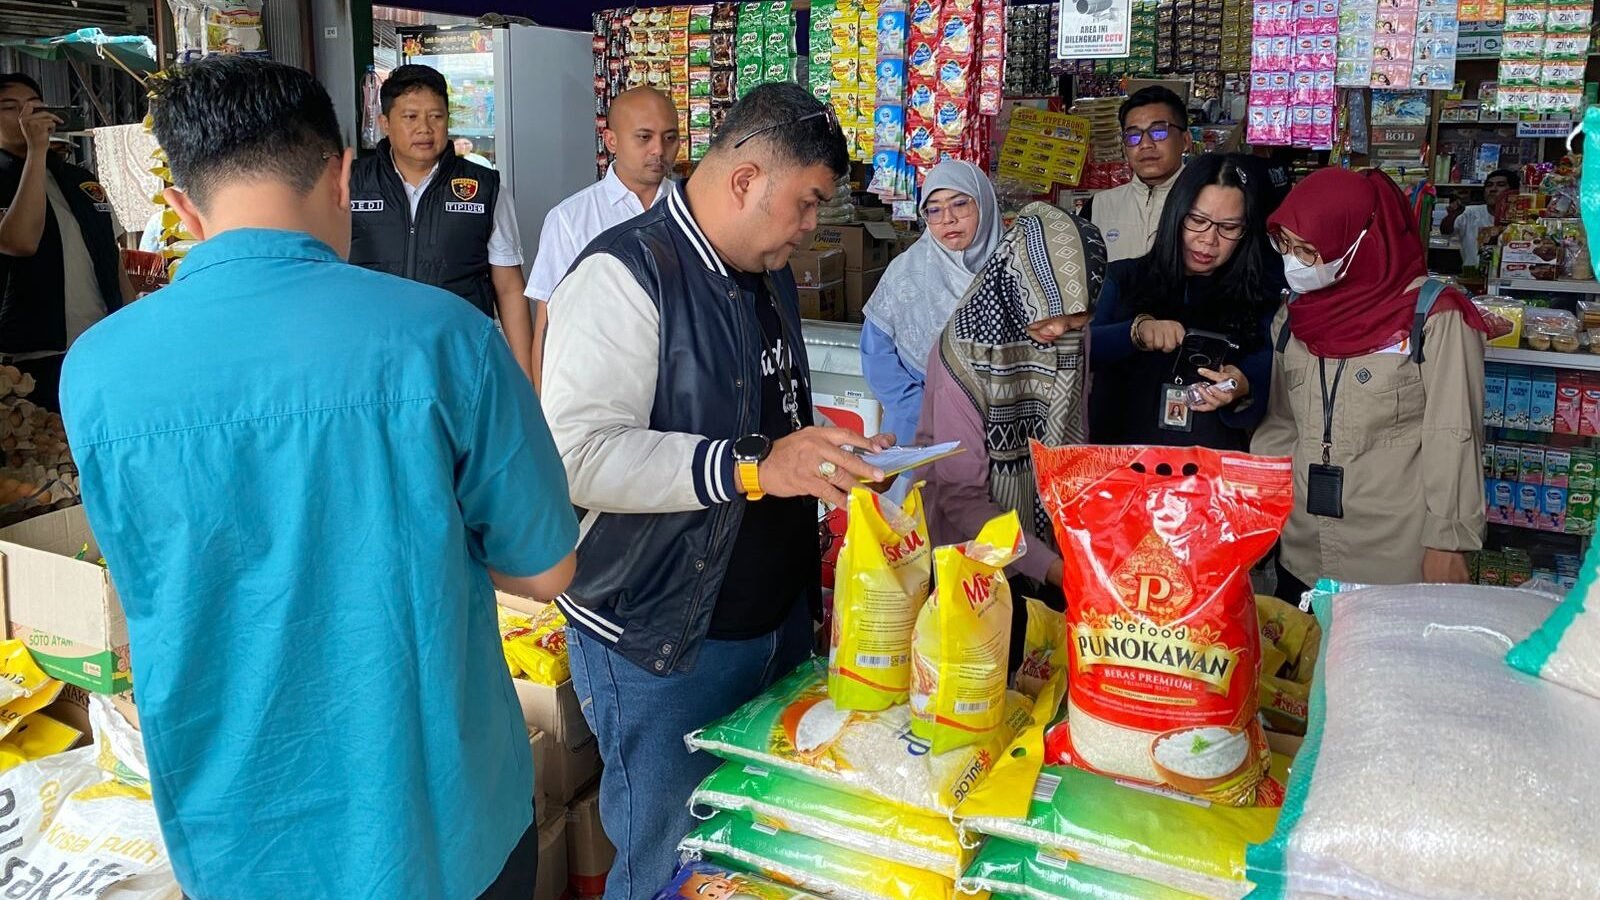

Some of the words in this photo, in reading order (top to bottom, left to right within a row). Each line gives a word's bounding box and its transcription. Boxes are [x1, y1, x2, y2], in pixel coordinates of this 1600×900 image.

[1559, 13, 1580, 21] ZINC
[1080, 25, 1097, 33] AREA
[1098, 25, 1108, 33] INI
[1065, 34, 1104, 44] DILENGKAPI
[1104, 33, 1123, 42] CCTV
[1514, 40, 1534, 48] ZINC
[1552, 68, 1573, 76] ZINC
[1385, 132, 1415, 141] BOLD
[1571, 495, 1589, 503] MILO
[1135, 572, 1173, 613] P
[1112, 616, 1186, 640] befood
[29, 635, 49, 646] SOTO
[1078, 635, 1230, 679] PUNOKAWAN
[1104, 668, 1136, 681] BERAS
[1138, 671, 1193, 691] PREMIUM
[954, 760, 985, 803] BULOG
